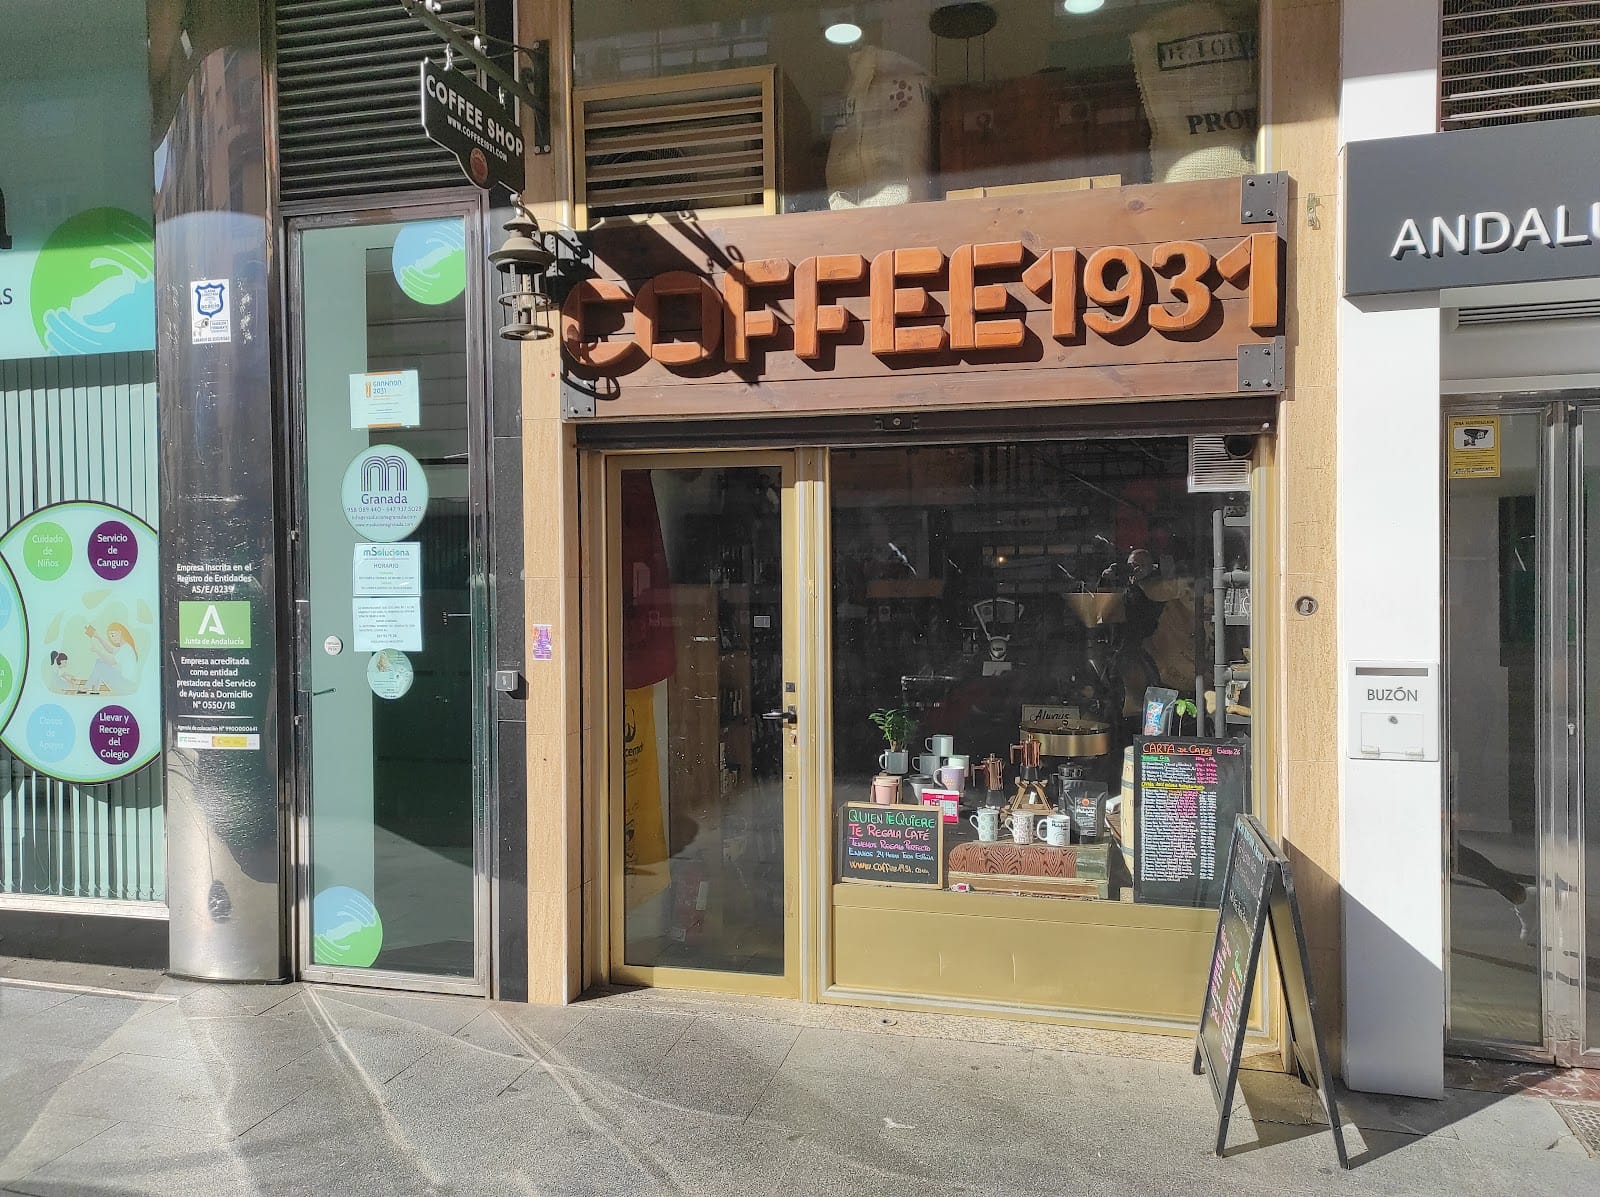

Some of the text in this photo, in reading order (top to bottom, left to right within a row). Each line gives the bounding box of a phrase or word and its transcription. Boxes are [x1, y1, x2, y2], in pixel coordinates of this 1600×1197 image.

[426, 75, 523, 156] COFFEE SHOP
[562, 232, 1278, 367] COFFEE1931
[361, 492, 408, 504] Granada
[32, 534, 64, 543] Cuidado
[97, 533, 128, 543] Servicio
[42, 546, 53, 555] de
[107, 545, 118, 555] de
[37, 557, 59, 568] Niños
[97, 558, 129, 570] Canguro
[177, 564, 205, 573] Empresa
[244, 563, 252, 571] el
[177, 574, 252, 584] Registro de Entidades
[184, 637, 201, 645] Junta
[180, 656, 250, 666] Empresa acreditada
[210, 668, 238, 676] entidad
[177, 679, 211, 688] prestadora
[225, 679, 256, 688] Servicio
[179, 689, 187, 697] de
[188, 690, 209, 699] Ayuda
[216, 690, 253, 698] Domicilio
[1366, 686, 1418, 702] BUZÓN
[202, 701, 236, 709] 0550/18
[99, 712, 129, 724] Llevar y
[99, 725, 130, 736] Recoger
[108, 737, 120, 746] del
[1142, 743, 1175, 753] CARTA
[100, 749, 130, 760] Colegio
[848, 809, 935, 828] QUIEN TE QUIERE
[848, 823, 864, 837] TE
